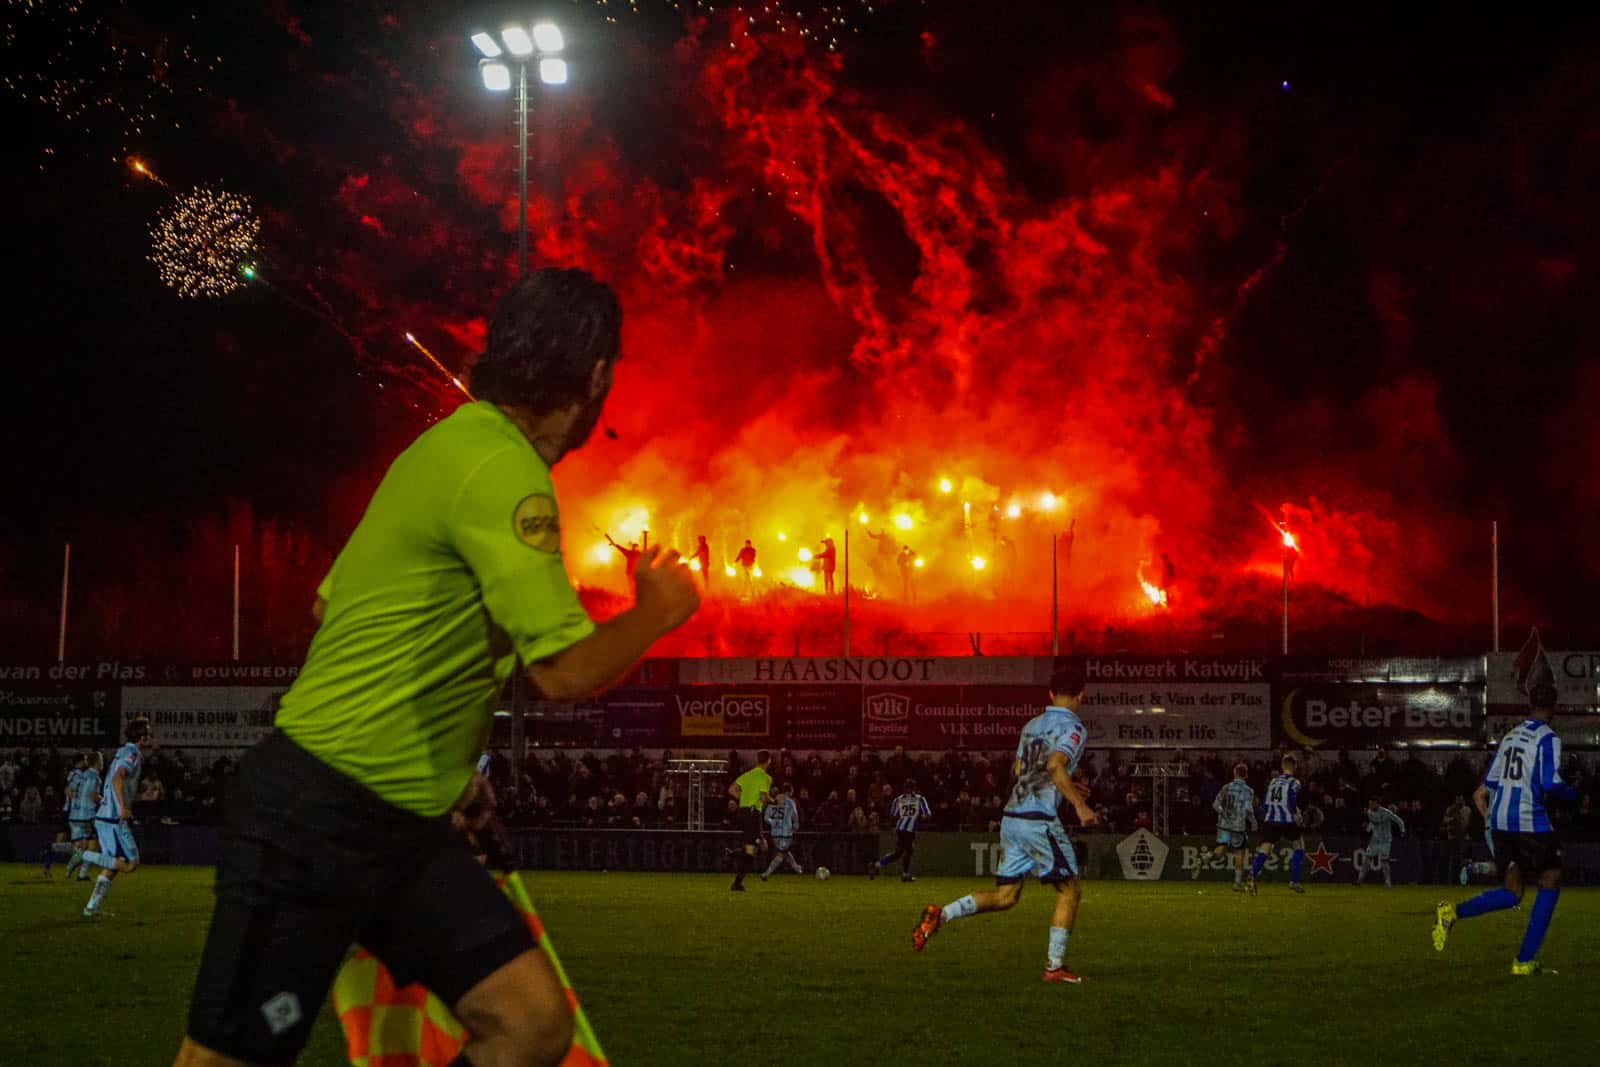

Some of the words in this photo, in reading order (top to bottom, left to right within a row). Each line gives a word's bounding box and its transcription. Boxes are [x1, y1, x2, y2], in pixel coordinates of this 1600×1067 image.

[0, 664, 40, 680] van
[48, 661, 91, 680] der
[96, 661, 146, 680] Plas
[756, 659, 935, 680] HAASNOOT
[1085, 659, 1177, 678] Hekwerk
[1184, 659, 1264, 681] Katwijk
[1080, 692, 1145, 706] arlevliet
[1149, 692, 1162, 706] &
[1165, 692, 1195, 706] Van
[1200, 692, 1227, 706] der
[1230, 692, 1263, 706] Plas
[198, 711, 238, 725] BOUW
[914, 703, 986, 717] Container
[1305, 700, 1399, 728] Beter
[1404, 700, 1473, 728] Bed
[939, 722, 970, 736] VLK
[1118, 724, 1153, 740] Fish
[1159, 724, 1184, 740] for
[1189, 724, 1217, 740] life
[1504, 746, 1525, 780] 15
[1271, 786, 1283, 802] 14
[771, 807, 784, 820] 25
[902, 804, 916, 817] 25
